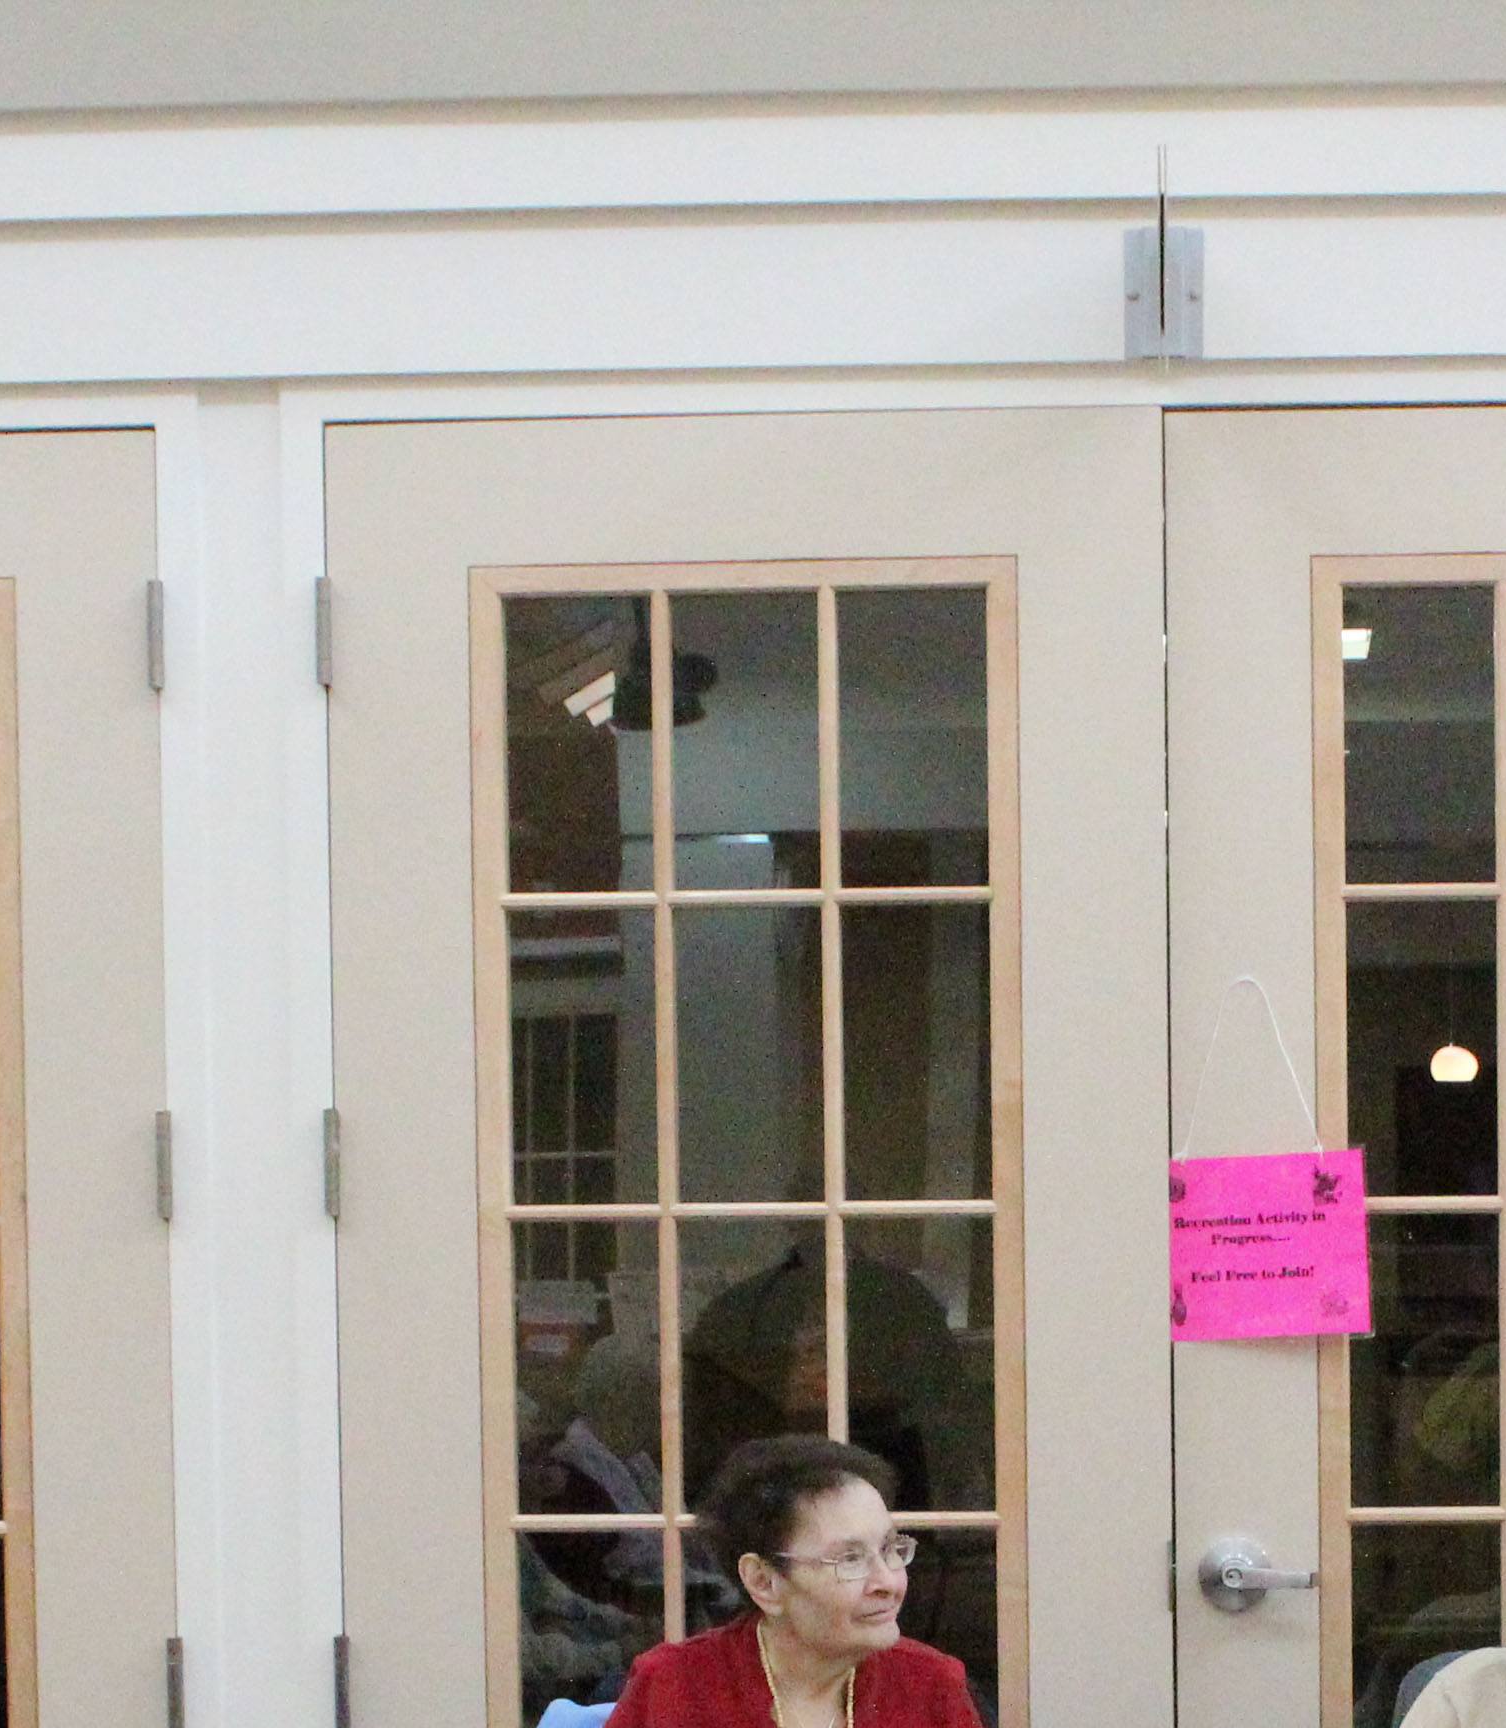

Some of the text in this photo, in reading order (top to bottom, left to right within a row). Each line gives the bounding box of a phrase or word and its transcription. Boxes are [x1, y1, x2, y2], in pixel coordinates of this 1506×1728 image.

[1174, 1210, 1326, 1229] Recreation Activity in
[1191, 1265, 1314, 1283] Feel Free to Join!
